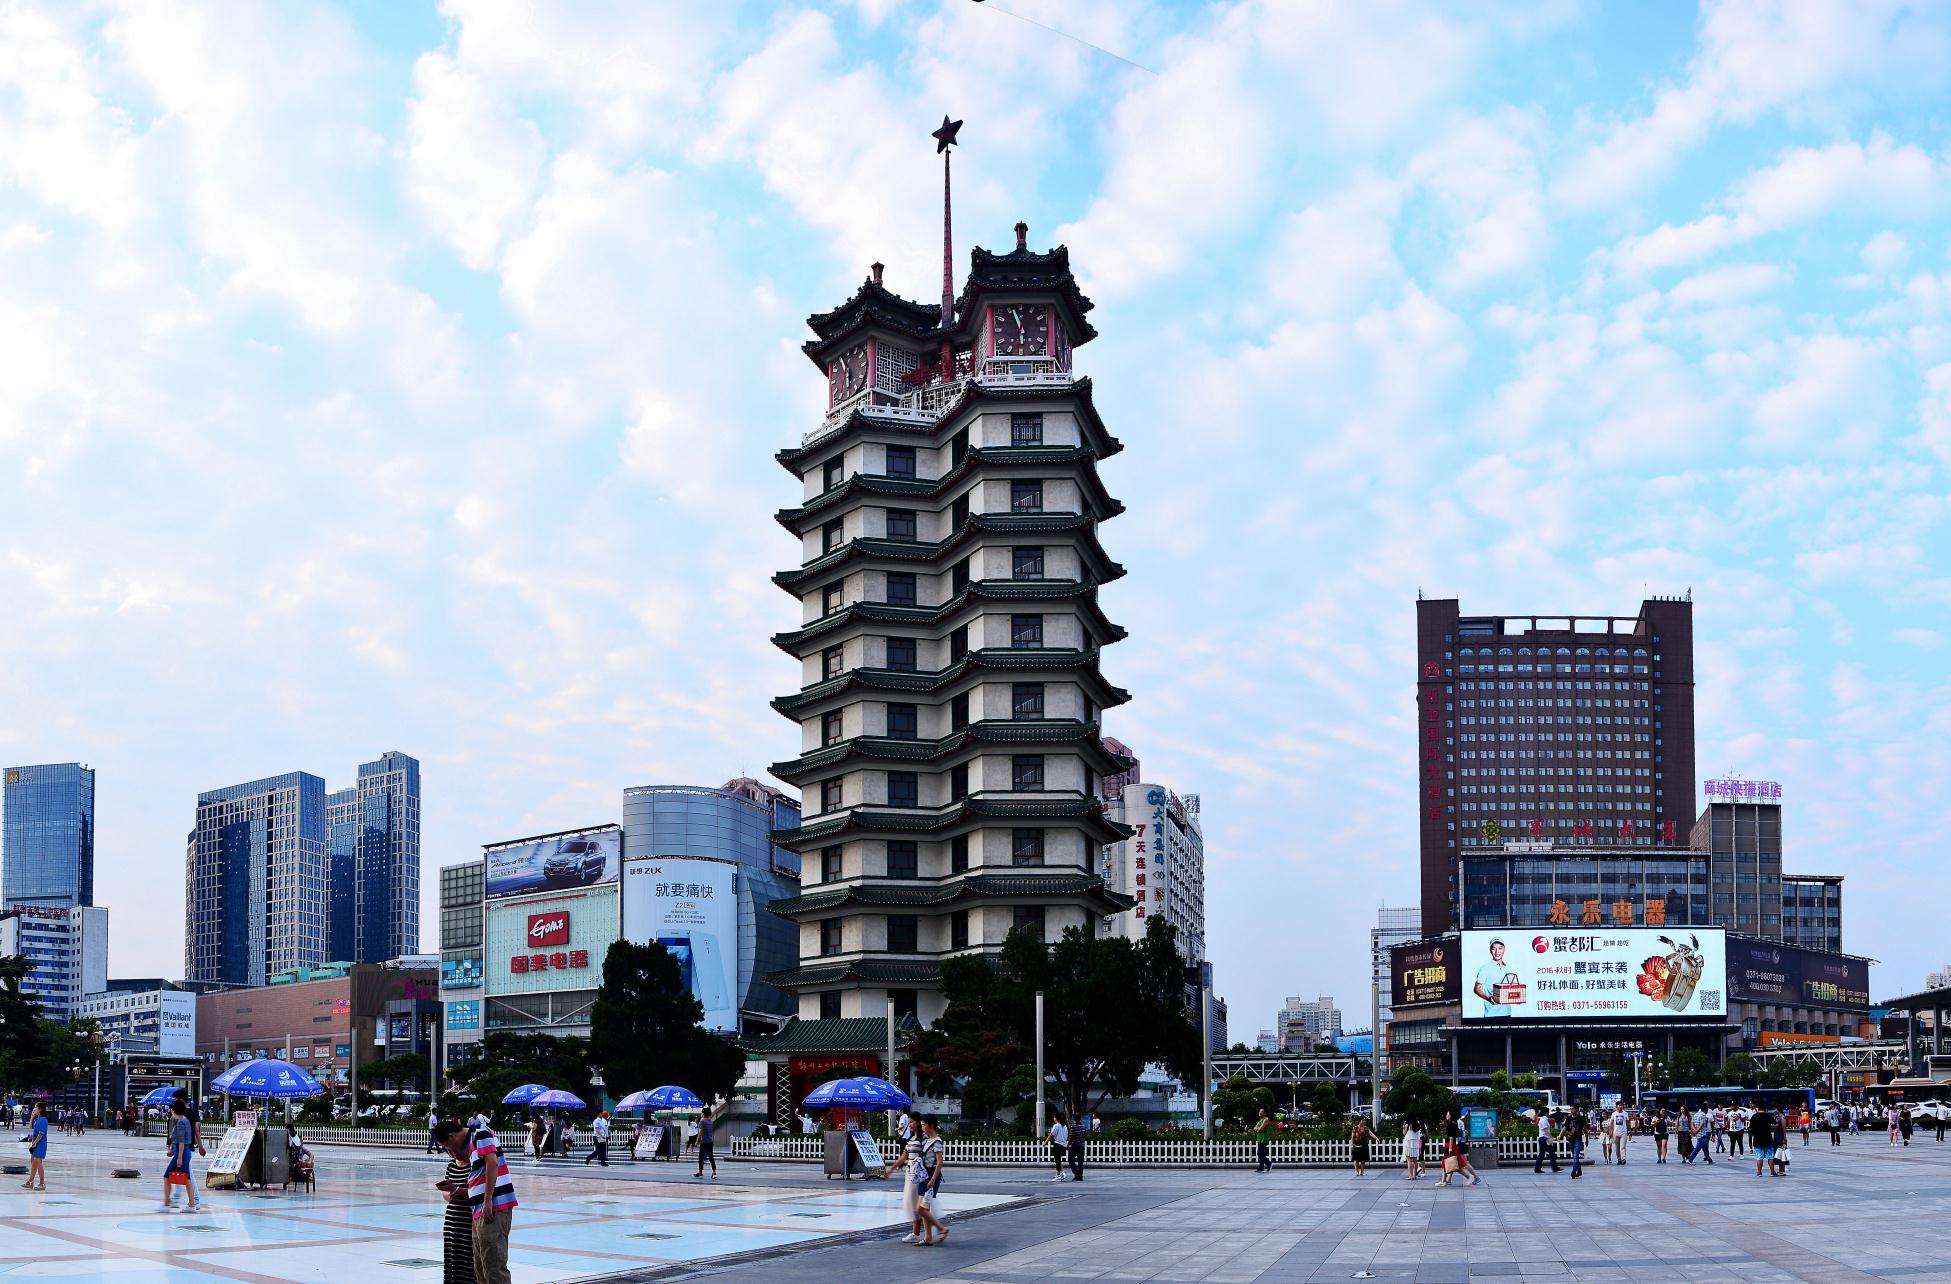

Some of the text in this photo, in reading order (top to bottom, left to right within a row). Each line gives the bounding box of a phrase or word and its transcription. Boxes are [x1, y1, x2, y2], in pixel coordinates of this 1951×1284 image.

[1704, 780, 1782, 797] 商城快捷酒店
[644, 867, 662, 875] ZUK
[1136, 824, 1146, 919] 7天连锁酒店
[655, 883, 714, 900] 就要痛快
[1550, 898, 1666, 925] 永乐电器
[1553, 936, 1602, 953] 蟹都汇
[511, 950, 588, 974] 国美电器
[1404, 966, 1446, 987] 广告招商
[1803, 980, 1838, 1001] 广告招商
[169, 1012, 191, 1022] Vaillant
[1600, 1041, 1643, 1049] 永乐生活电器
